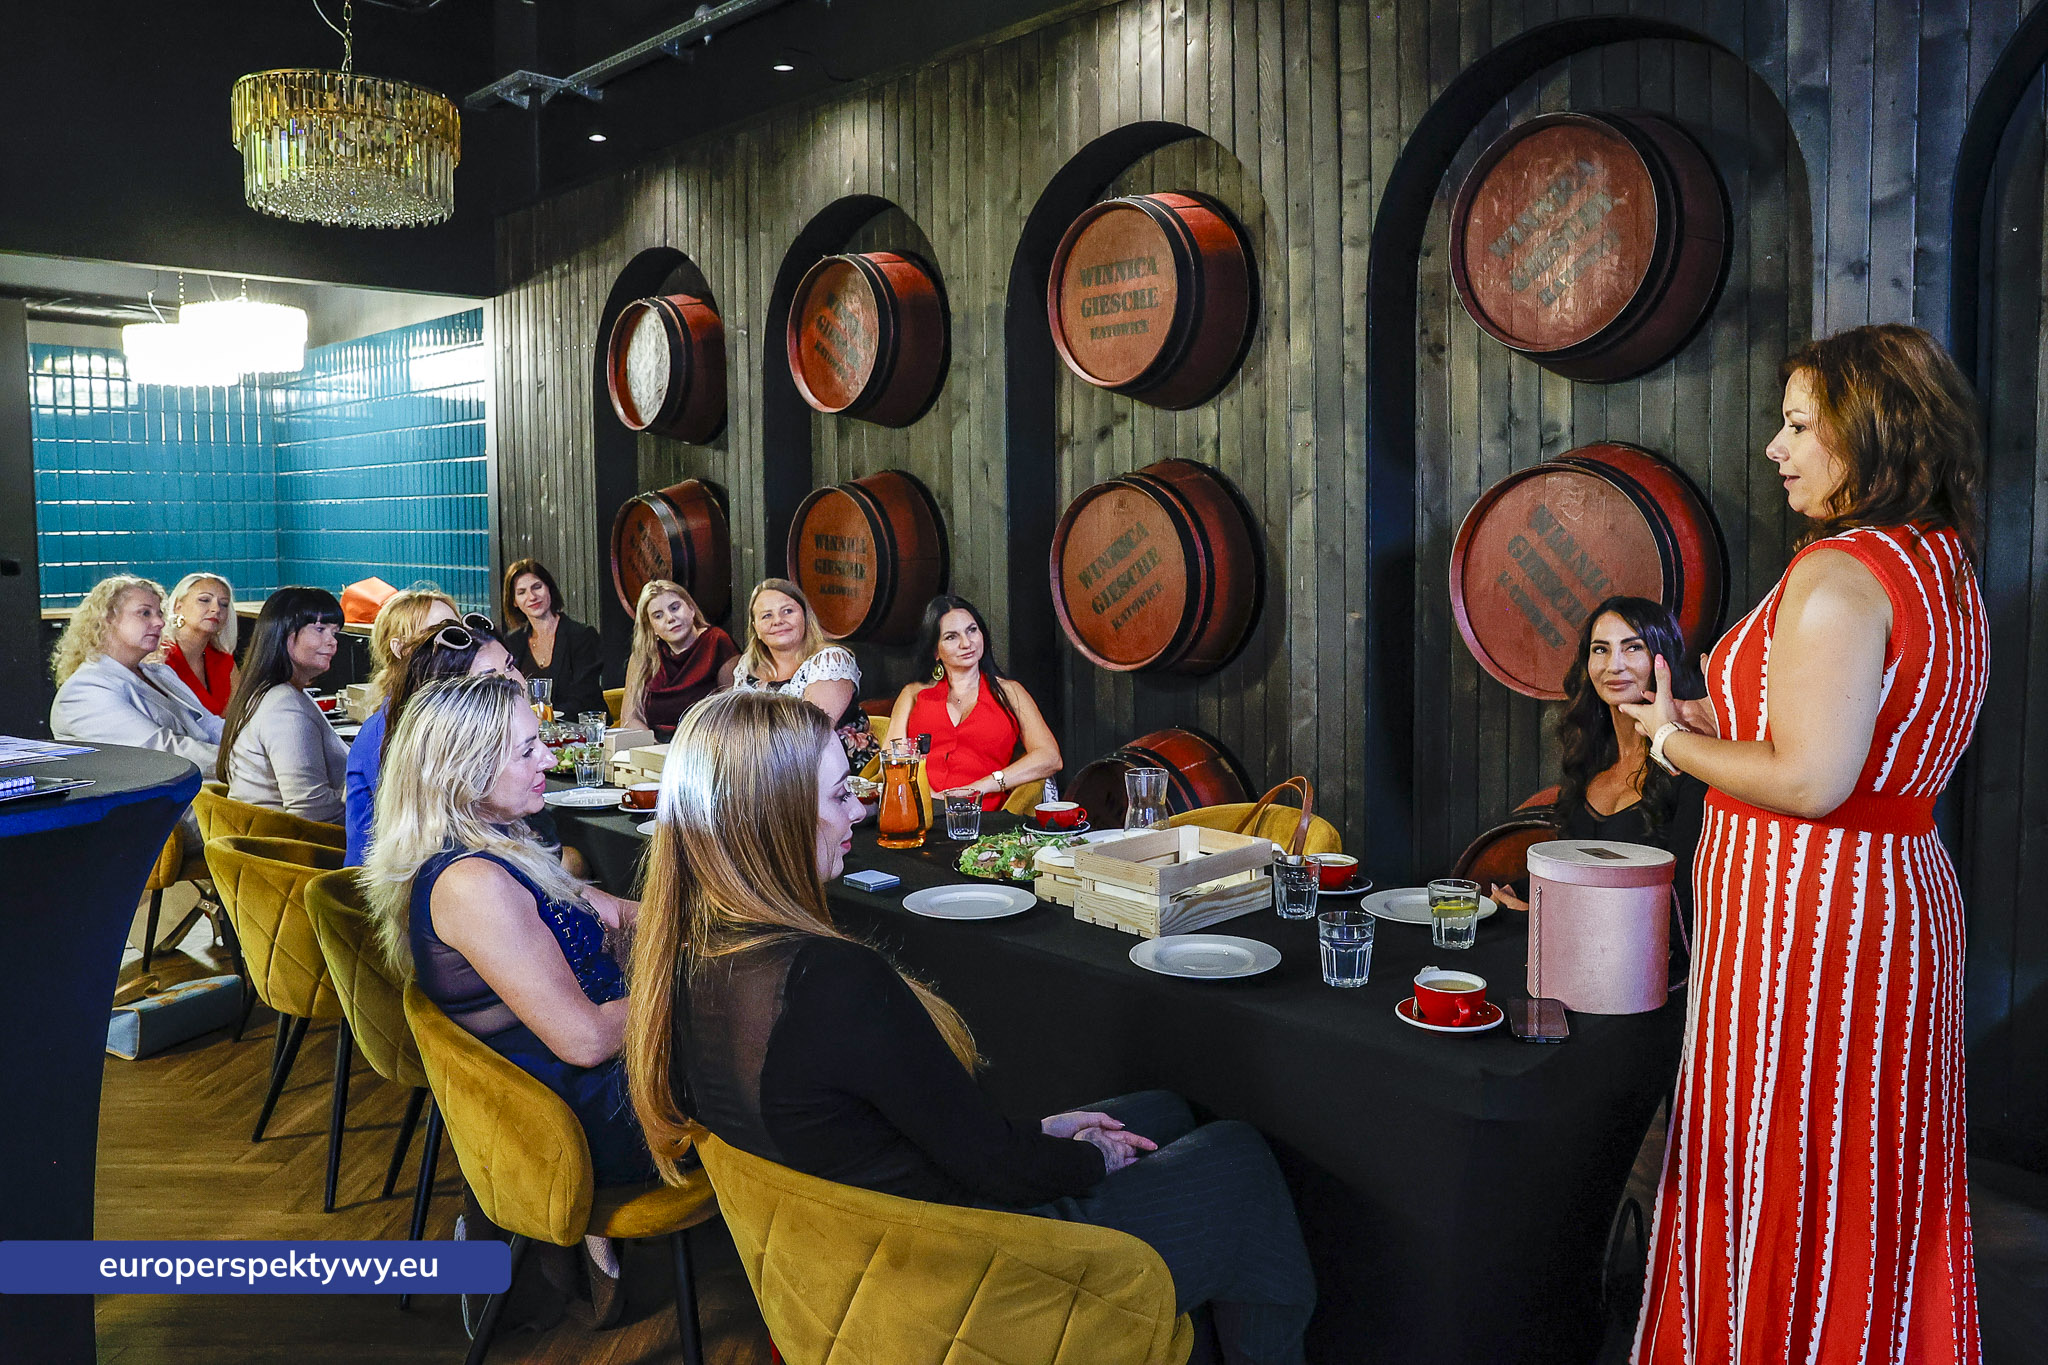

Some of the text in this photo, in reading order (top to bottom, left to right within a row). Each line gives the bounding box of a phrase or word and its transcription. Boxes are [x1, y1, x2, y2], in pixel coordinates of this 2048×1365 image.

[1080, 256, 1158, 287] WINNICA
[1081, 287, 1160, 318] GIESCHE
[1090, 319, 1150, 341] KATOWICE
